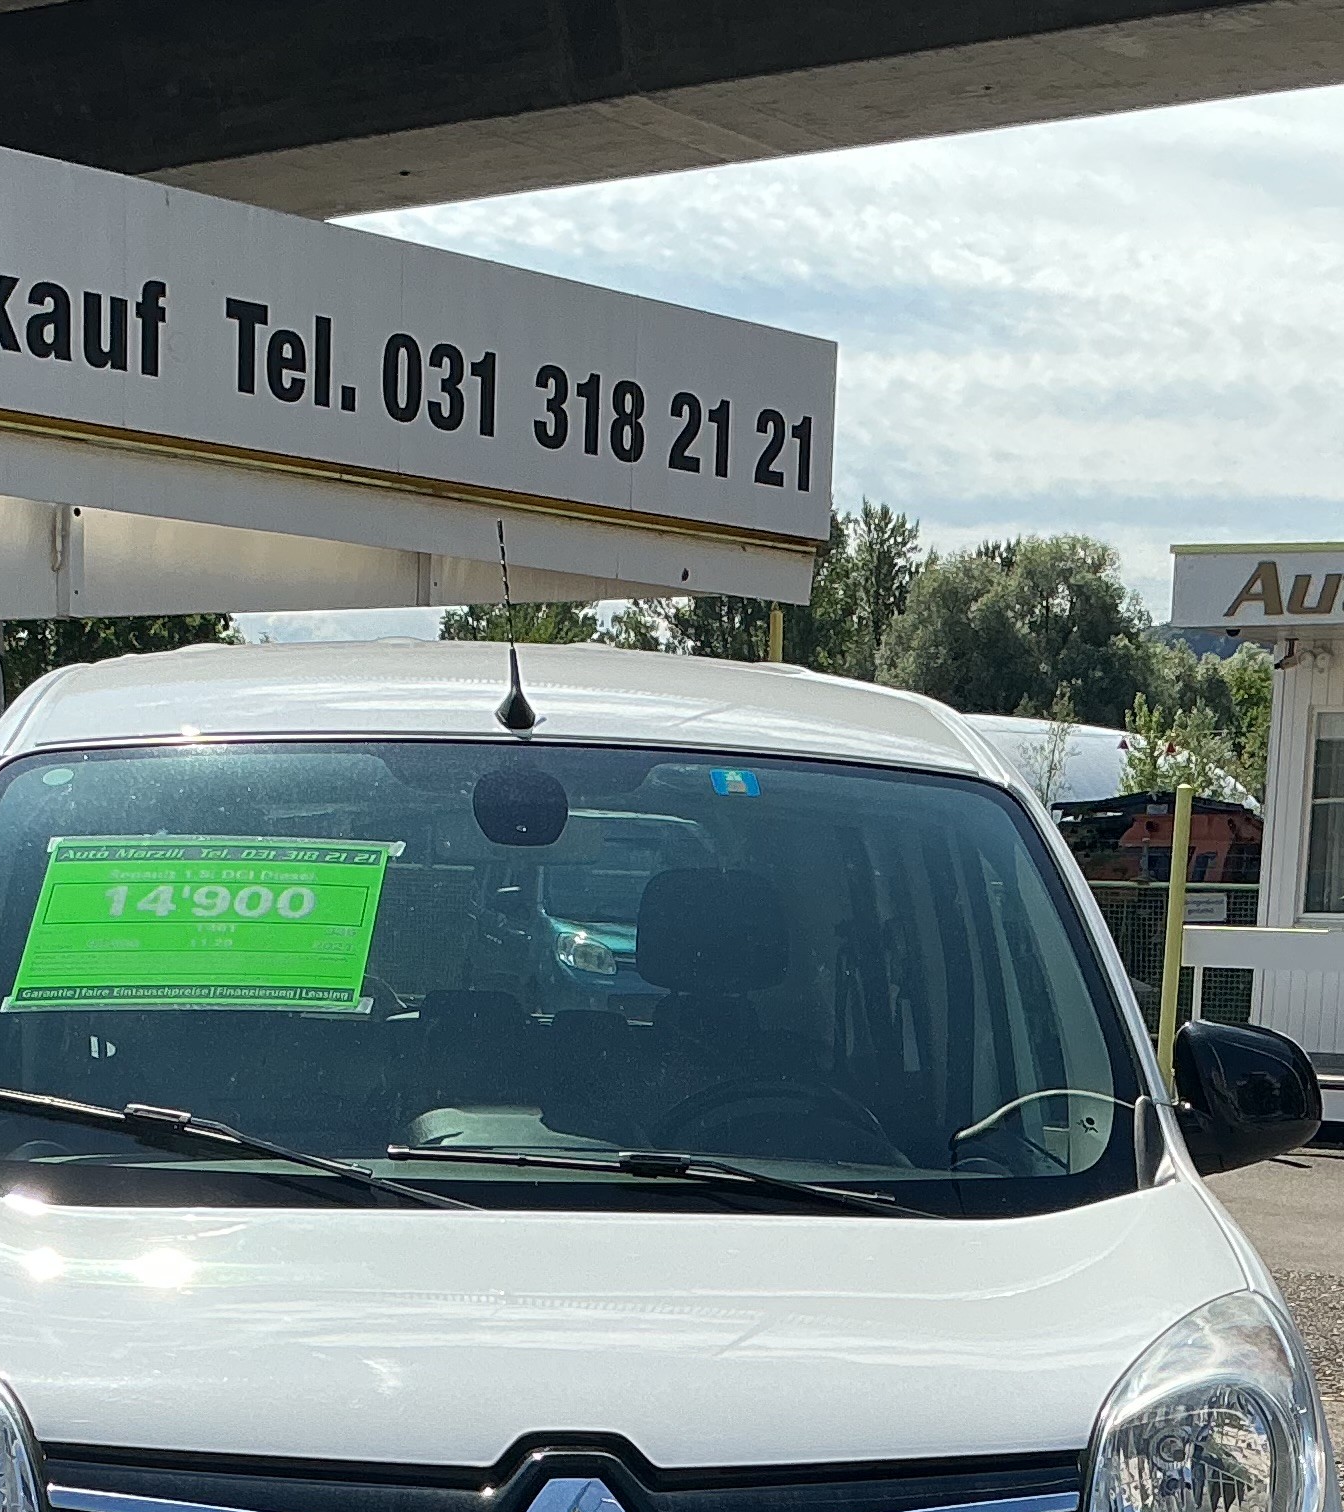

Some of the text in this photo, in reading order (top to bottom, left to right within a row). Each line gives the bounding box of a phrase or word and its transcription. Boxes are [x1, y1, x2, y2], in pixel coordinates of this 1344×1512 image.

[225, 297, 357, 413] Tel.
[382, 332, 497, 438] 031
[533, 364, 646, 463] 318
[668, 391, 731, 478] 21
[753, 408, 814, 493] 21
[60, 847, 110, 860] Auto
[240, 849, 277, 860] 031
[325, 851, 348, 863] 21
[353, 853, 377, 864] 21
[105, 884, 317, 919] 14'900
